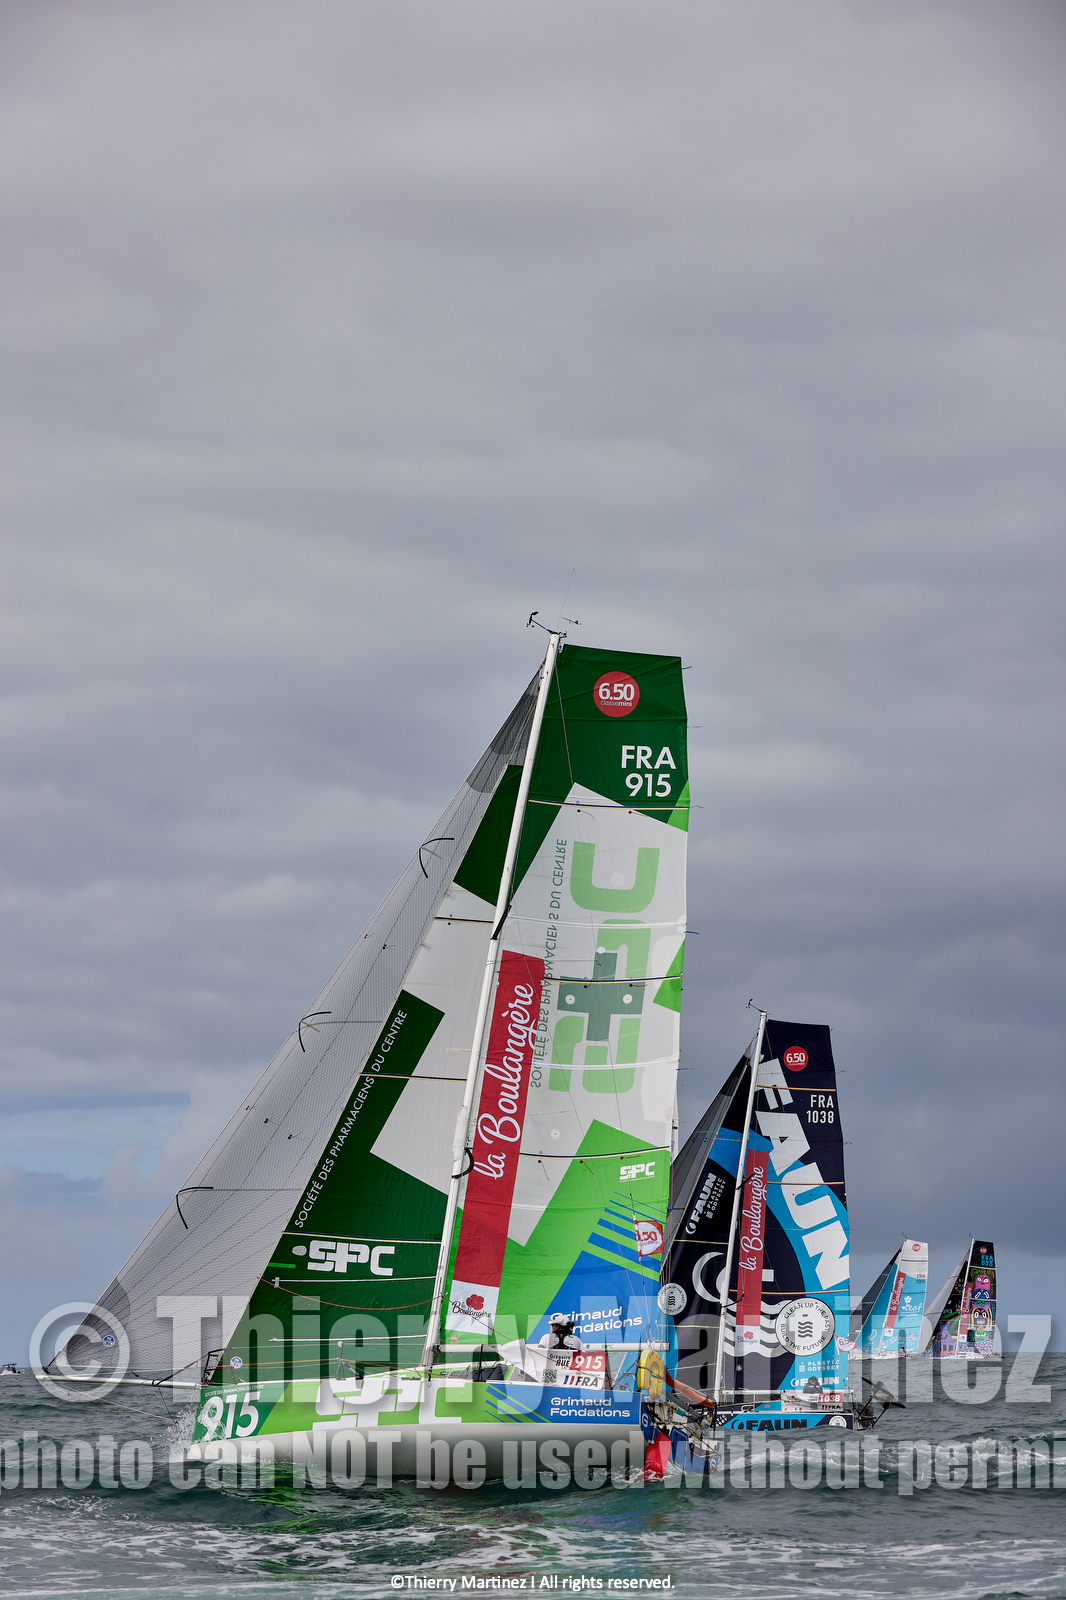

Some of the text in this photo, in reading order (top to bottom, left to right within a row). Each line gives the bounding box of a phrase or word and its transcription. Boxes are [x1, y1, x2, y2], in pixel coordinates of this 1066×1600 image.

[598, 682, 635, 701] 6.50
[621, 745, 676, 769] FRA
[625, 773, 672, 797] 915
[786, 1052, 806, 1064] 6.50
[474, 983, 537, 1180] la Boulangère
[810, 1094, 834, 1108] FRA
[294, 1009, 408, 1228] SOCIÉTÉ DES PHARMACIENS DU CENTRE
[806, 1110, 834, 1124] 1038
[619, 1161, 656, 1181] SPC
[690, 1172, 717, 1223] FAUN
[706, 1177, 723, 1209] PLASTIC
[712, 1179, 727, 1211] ODYSSEY
[738, 1166, 768, 1272] la Boulangère
[307, 1239, 396, 1277] SPC
[572, 1317, 642, 1333] ndations
[784, 1303, 804, 1319] CLEAN
[815, 1305, 826, 1315] THE
[823, 1315, 831, 1332] PAST
[780, 1323, 827, 1351] BUILD THE FUTURE
[574, 1355, 603, 1370] 915
[575, 1376, 598, 1387] FRA
[800, 1376, 840, 1387] FUN
[550, 1407, 630, 1418] Fondations
[551, 1397, 611, 1406] Grimaud
[202, 1391, 261, 1441] 915
[744, 1419, 808, 1432] FAUN
